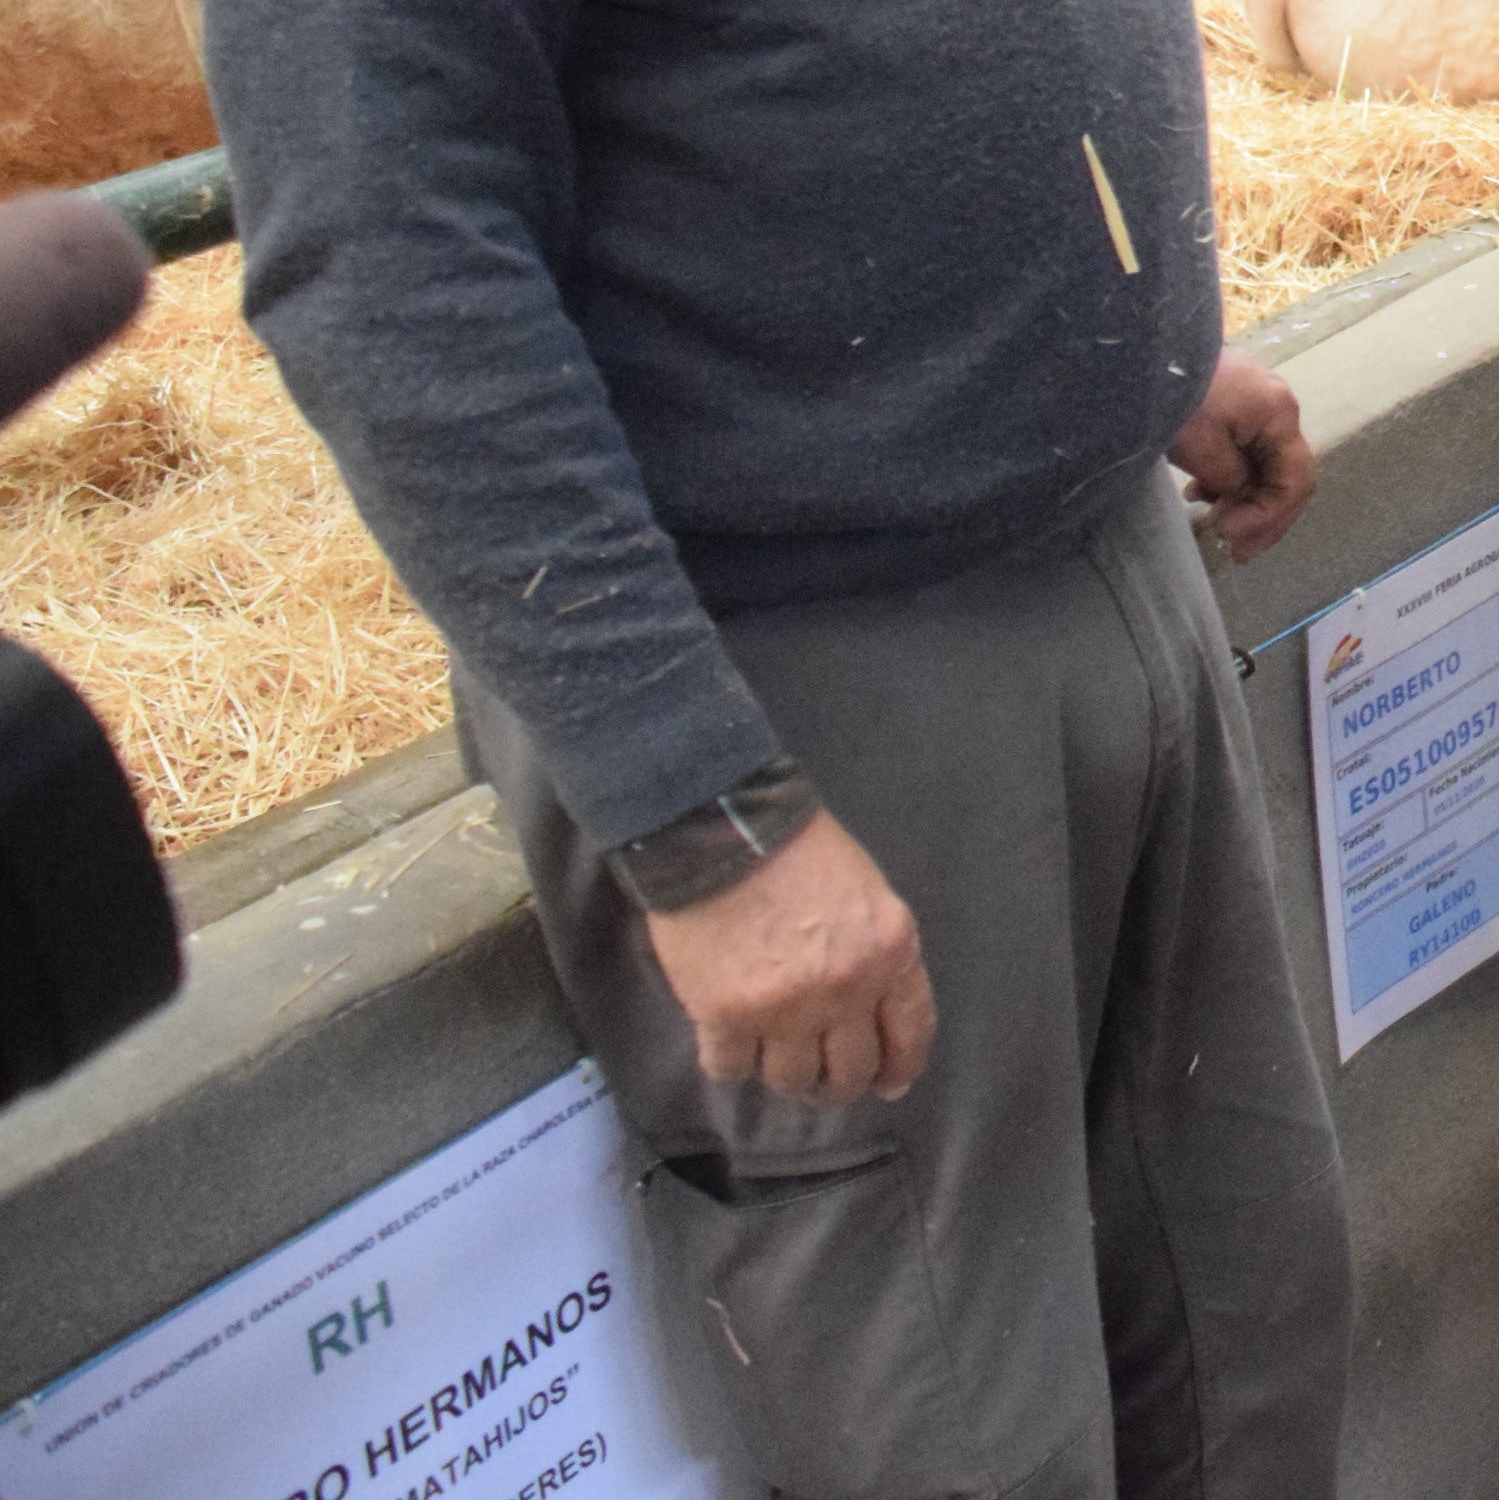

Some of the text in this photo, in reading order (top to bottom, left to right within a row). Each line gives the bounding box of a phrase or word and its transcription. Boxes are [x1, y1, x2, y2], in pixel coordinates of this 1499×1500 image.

[1342, 651, 1461, 738] NORBERTO
[1408, 878, 1476, 934] GALENO
[377, 1195, 440, 1242] SELECTO
[307, 1279, 394, 1375] RH
[283, 1270, 613, 1500] O HERMANOS
